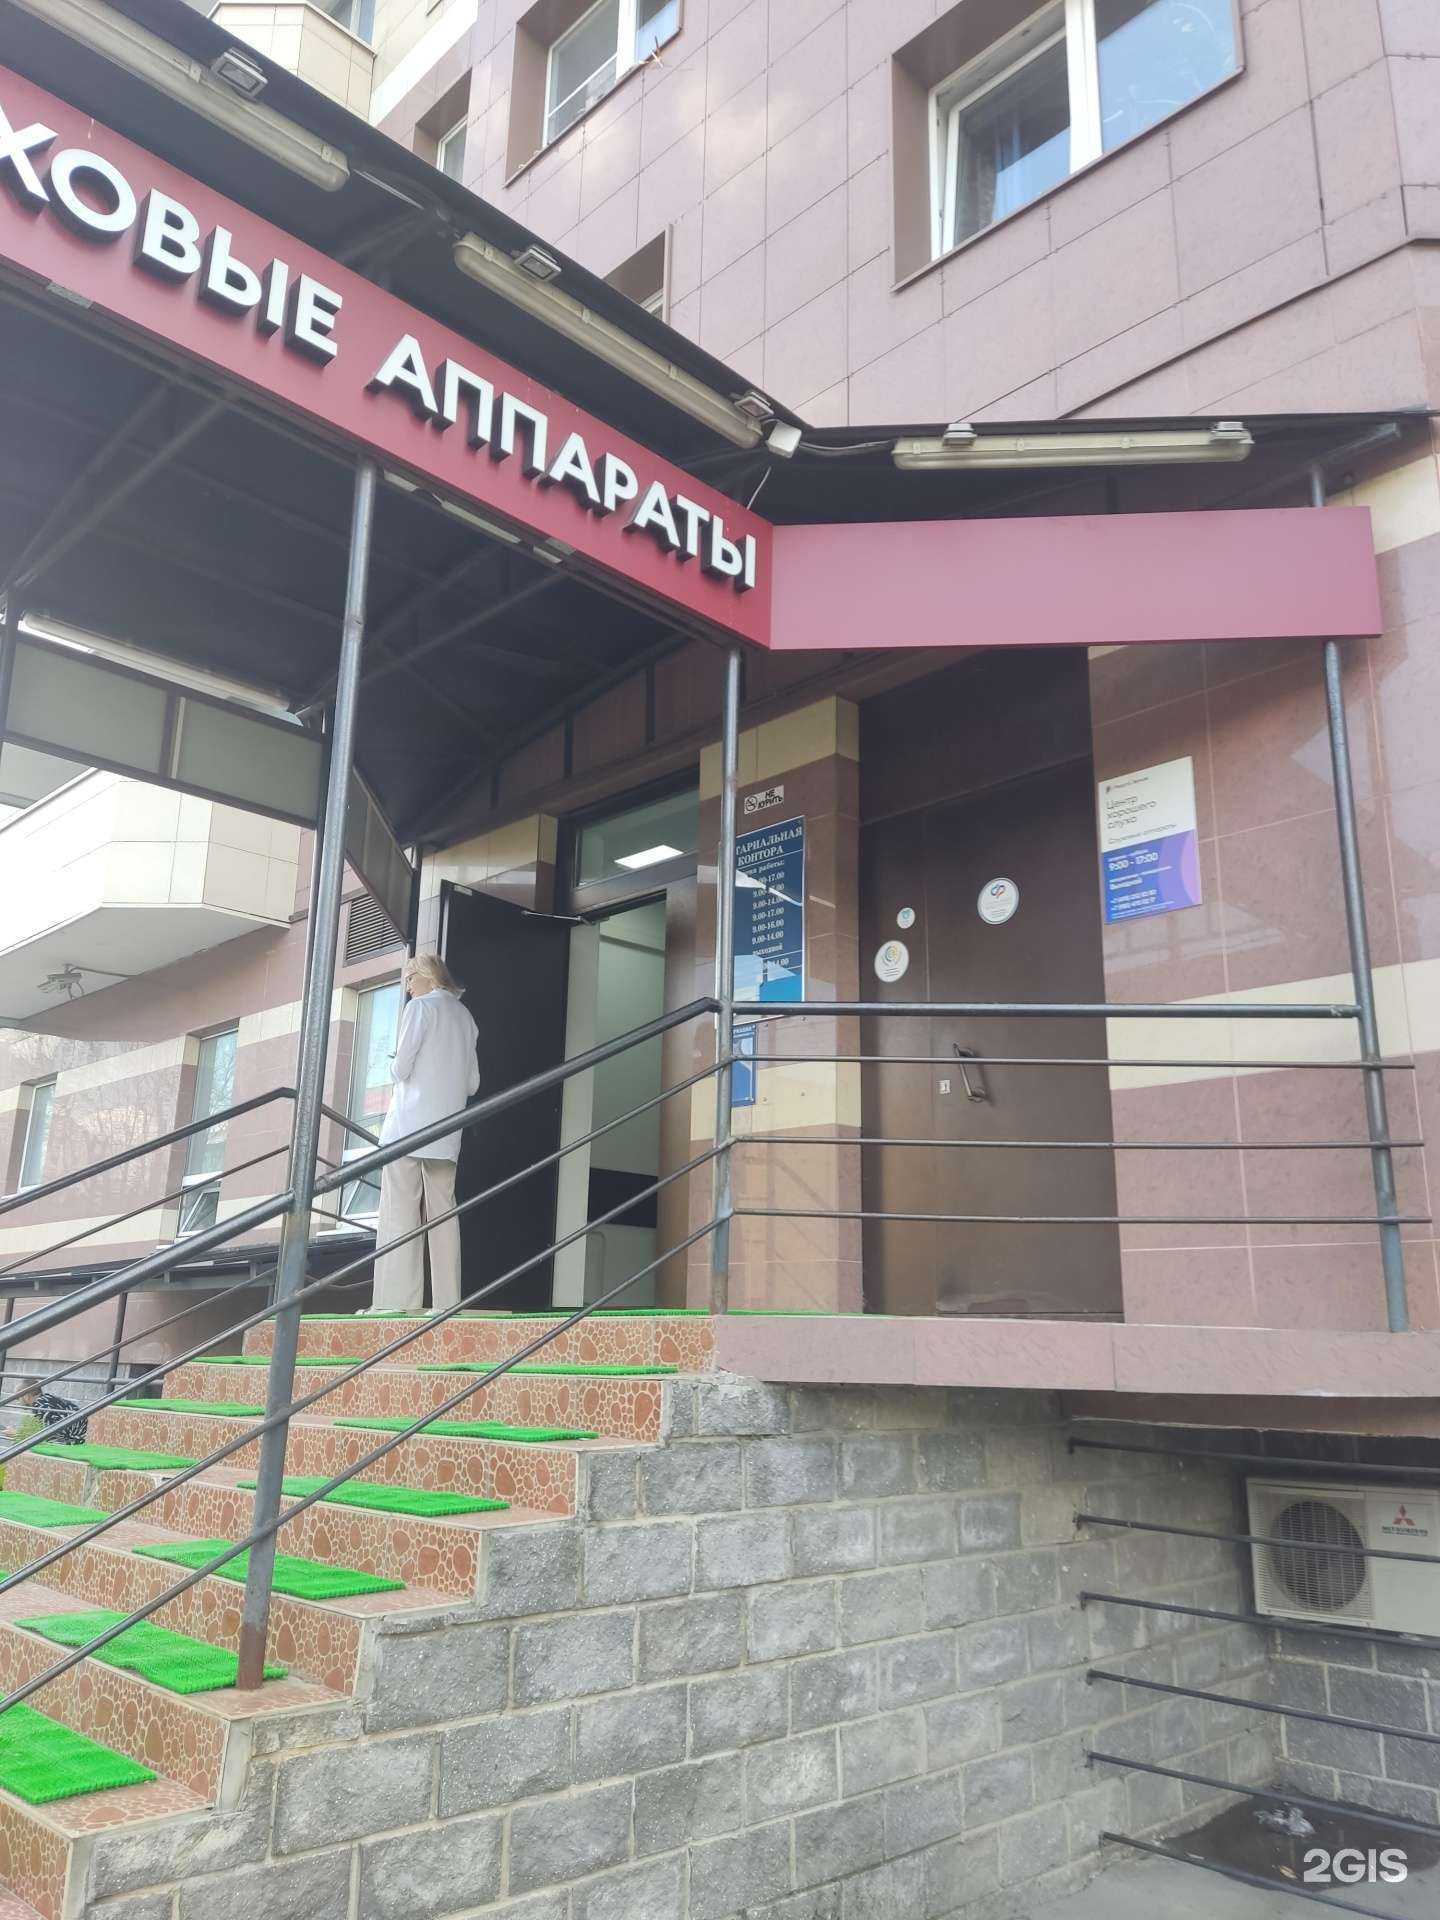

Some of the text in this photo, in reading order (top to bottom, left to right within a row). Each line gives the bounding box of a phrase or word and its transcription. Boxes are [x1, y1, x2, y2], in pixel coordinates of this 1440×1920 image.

[370, 333, 757, 591] АППАРАТЫ
[765, 789, 775, 799] НЕ
[738, 846, 784, 867] КОНТОРА
